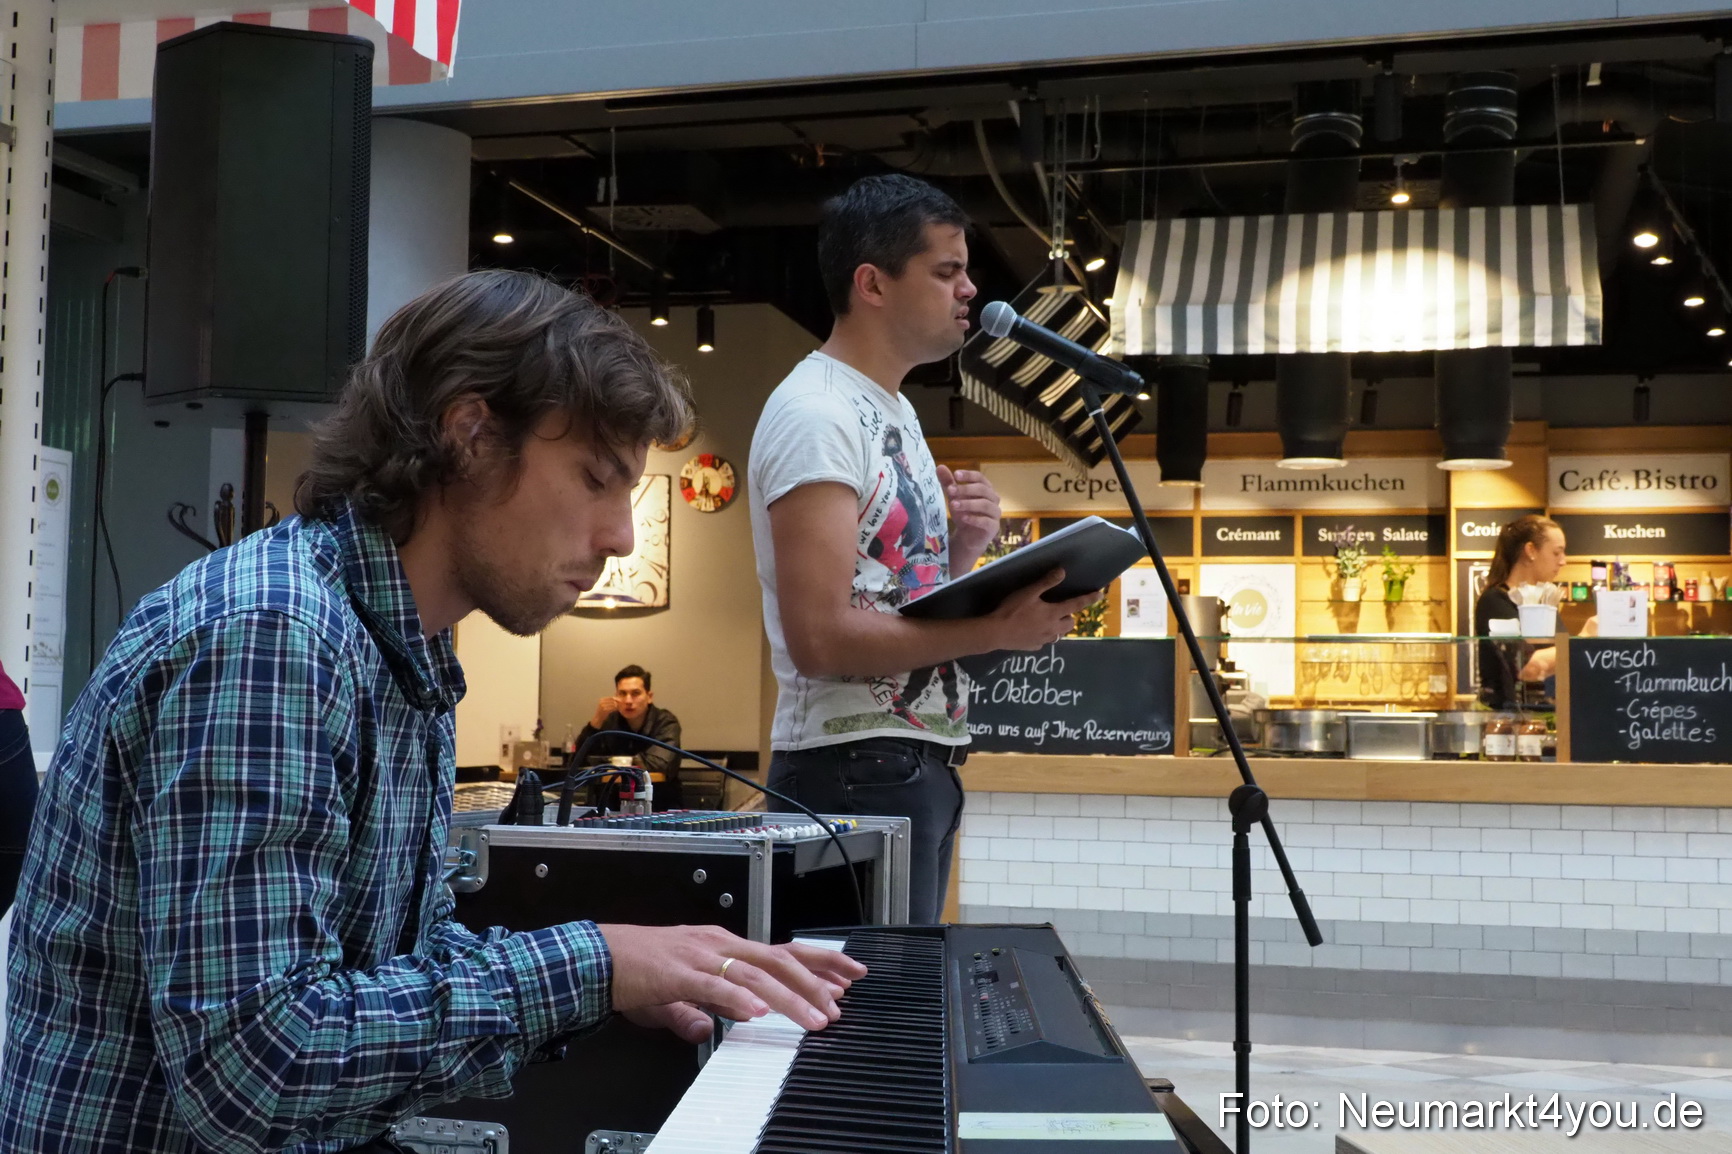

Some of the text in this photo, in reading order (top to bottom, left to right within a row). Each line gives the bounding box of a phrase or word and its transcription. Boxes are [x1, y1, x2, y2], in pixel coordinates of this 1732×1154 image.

[1241, 473, 1405, 493] Flammkuchen
[1216, 527, 1281, 542] Crémant
[1382, 527, 1428, 542] Salate
[1603, 523, 1666, 539] Kuchen
[1001, 643, 1065, 674] runch
[1585, 642, 1656, 669] versch
[991, 677, 1083, 706] Oktober
[1024, 721, 1050, 745] auf
